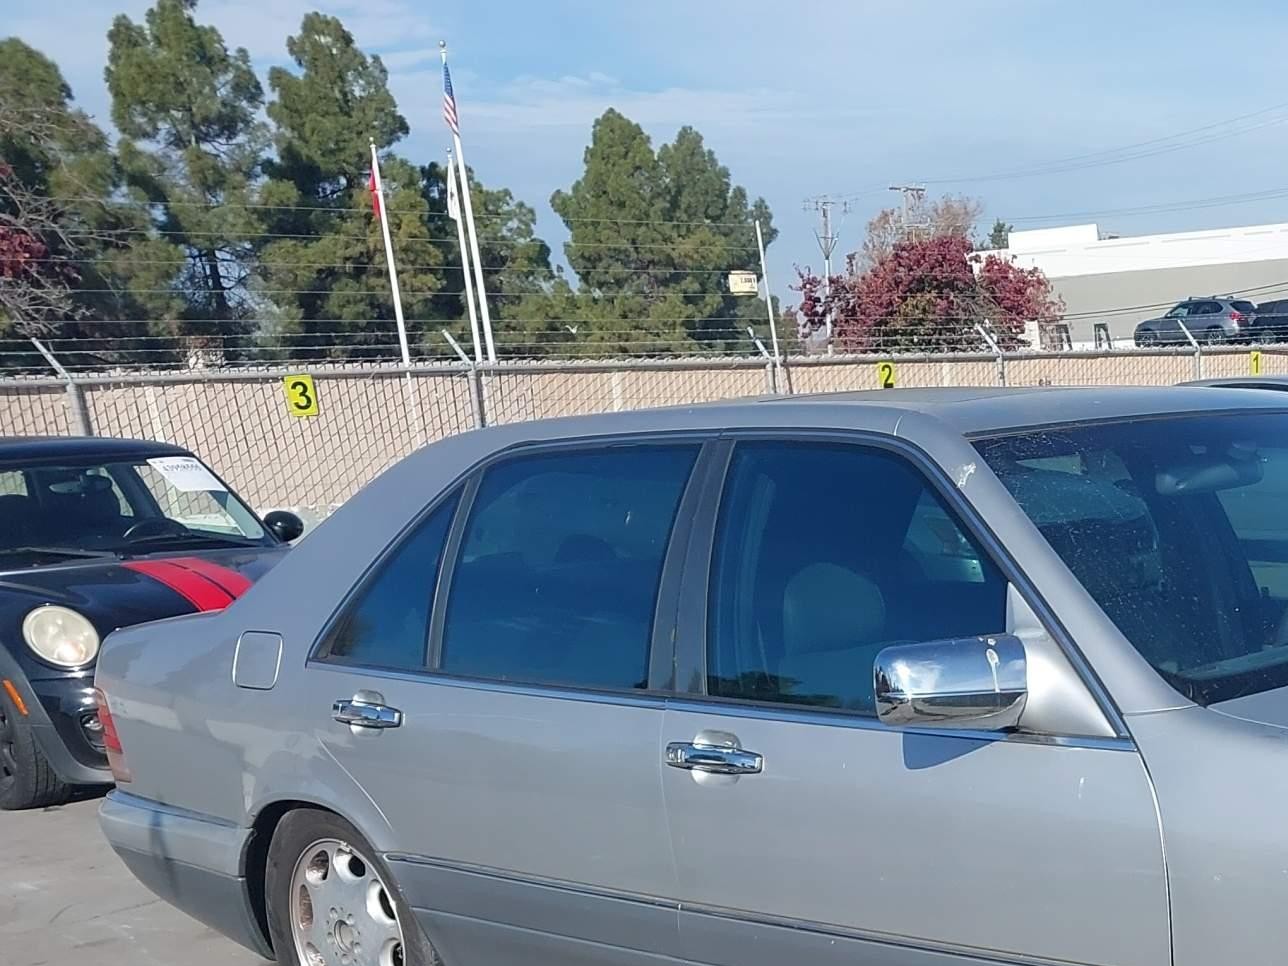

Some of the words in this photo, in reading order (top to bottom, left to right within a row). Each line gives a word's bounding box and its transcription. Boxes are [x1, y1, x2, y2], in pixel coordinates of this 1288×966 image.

[1252, 353, 1259, 374] 1
[881, 364, 894, 389] 2
[290, 381, 312, 410] 3
